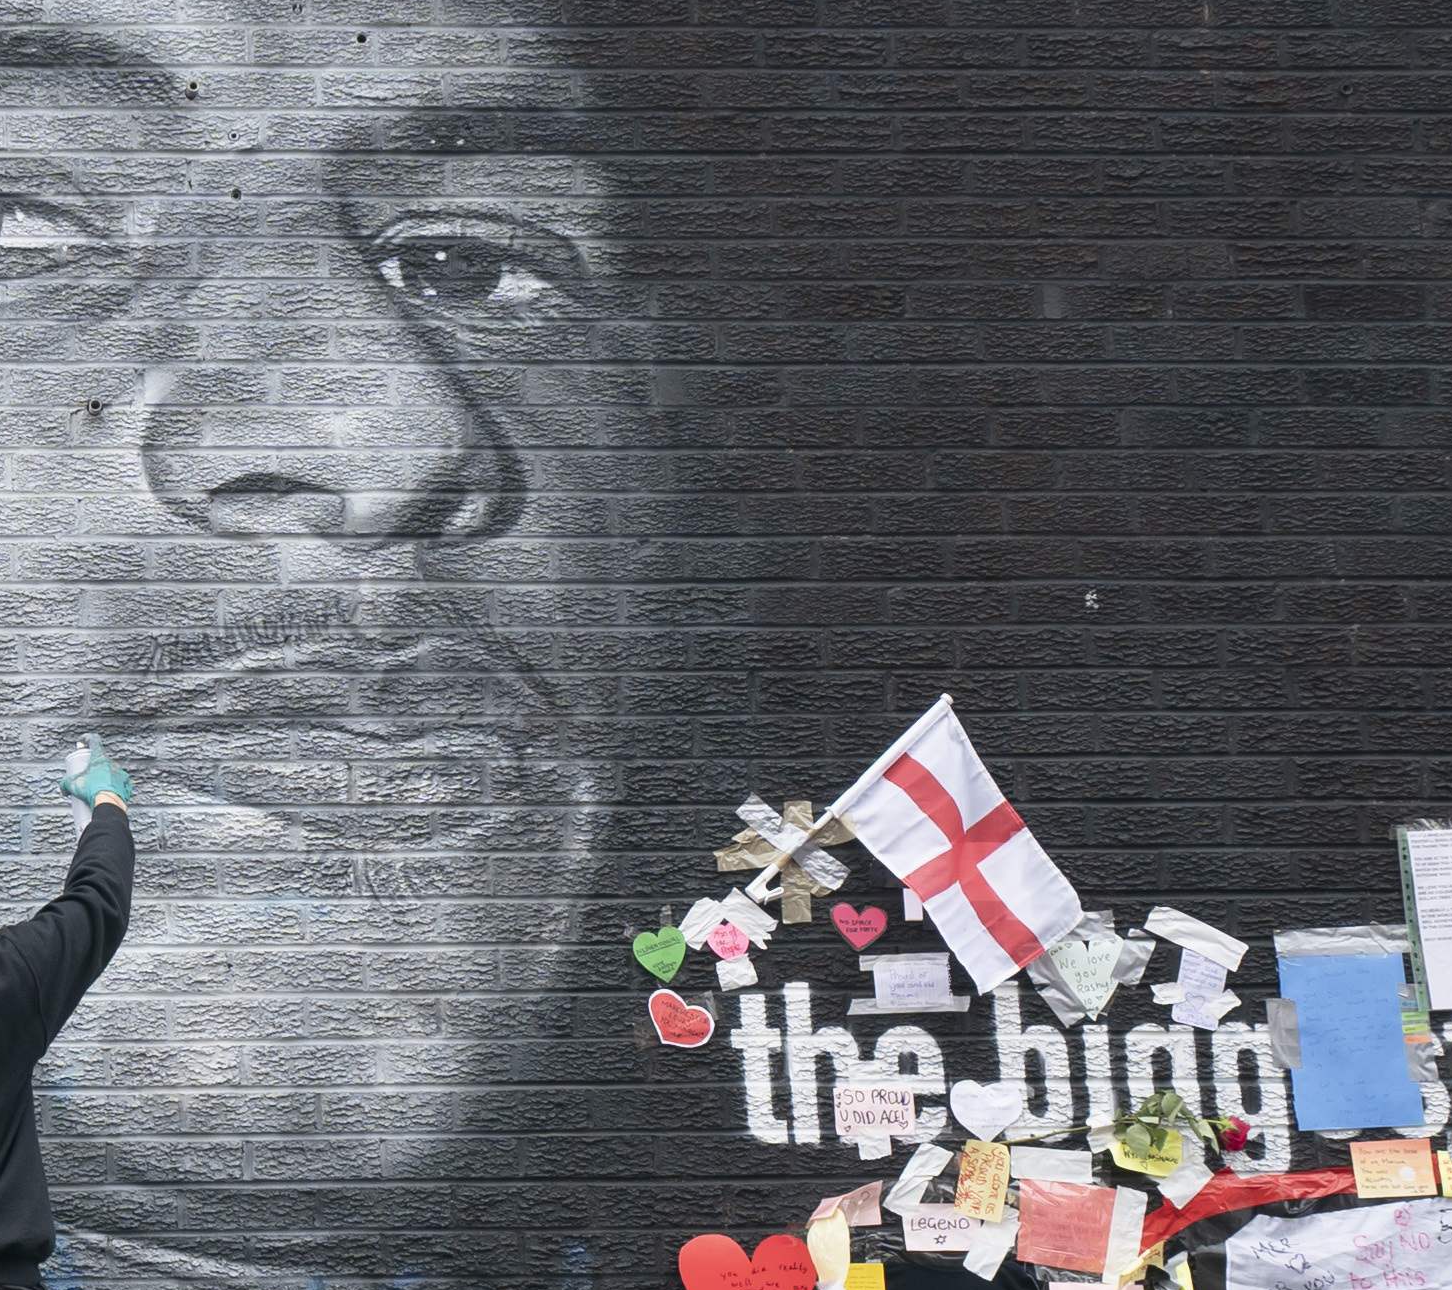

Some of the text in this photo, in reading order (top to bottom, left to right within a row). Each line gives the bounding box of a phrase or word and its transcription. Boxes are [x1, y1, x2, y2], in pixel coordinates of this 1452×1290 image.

[1057, 952, 1110, 970] We love
[729, 981, 950, 1147] the
[844, 1088, 910, 1107] SO PROUD
[856, 1108, 881, 1125] DID
